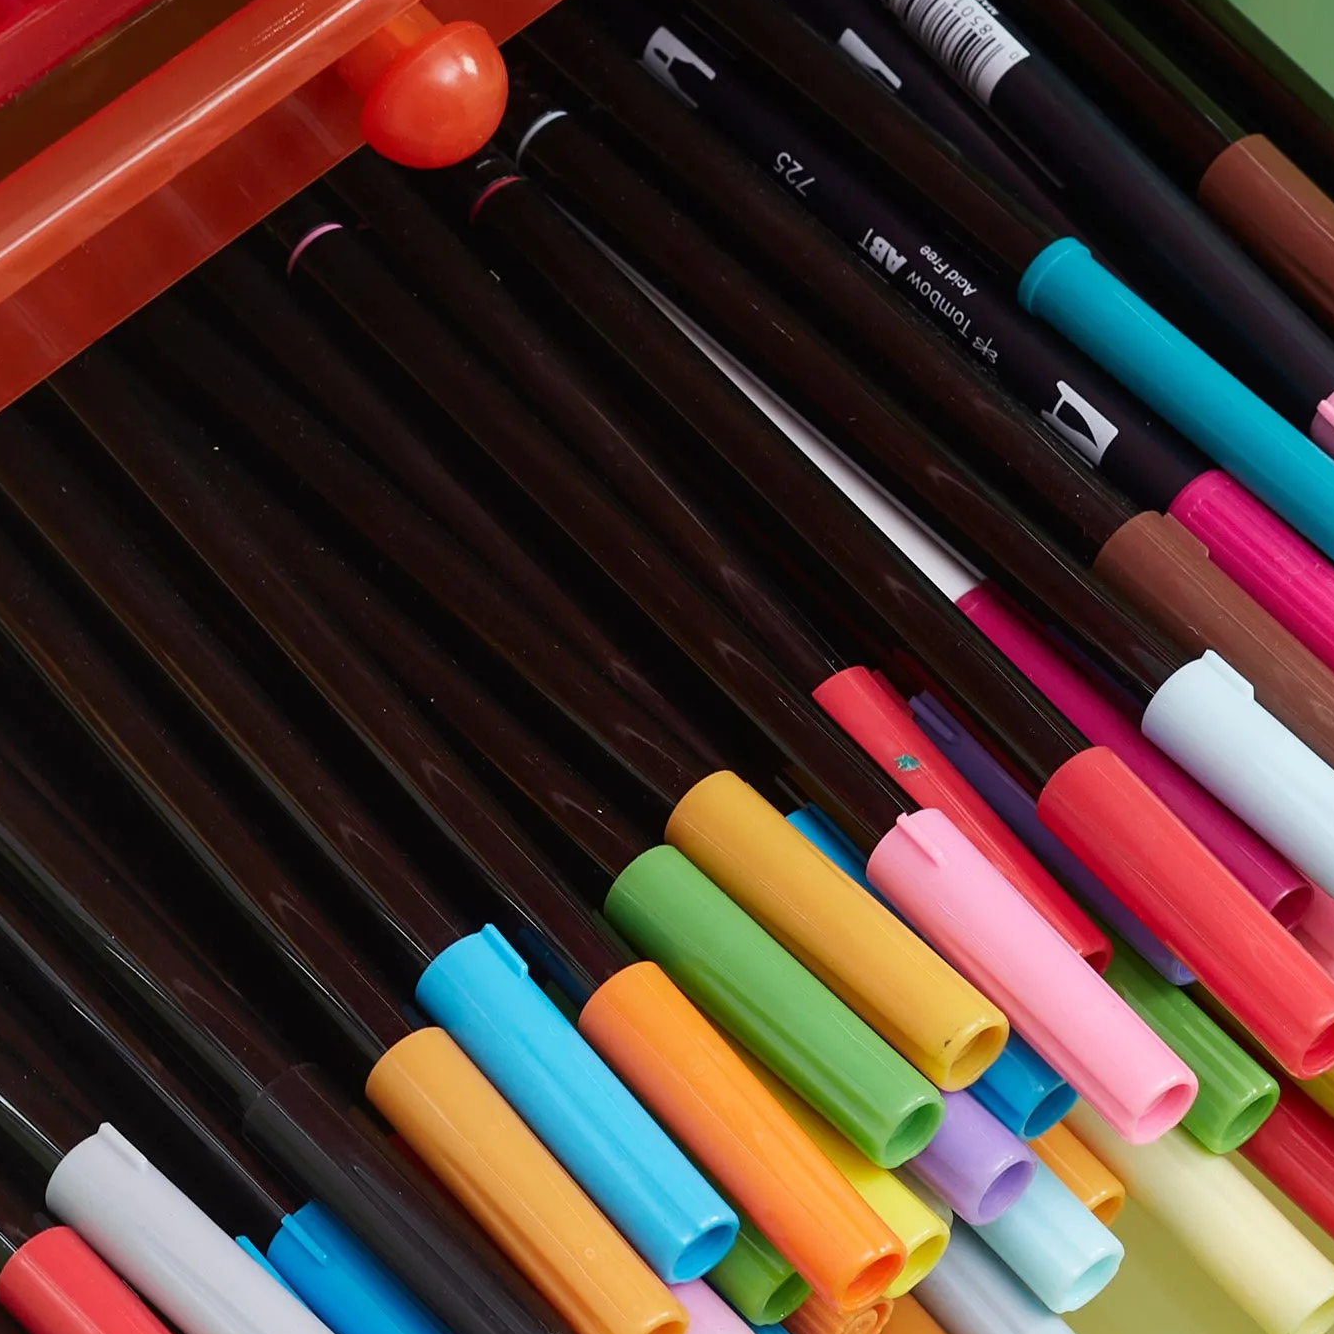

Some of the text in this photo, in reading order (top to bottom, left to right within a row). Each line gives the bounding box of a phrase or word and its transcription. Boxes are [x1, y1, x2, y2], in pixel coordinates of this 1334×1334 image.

[772, 151, 972, 339] Tombow ABT 725
[919, 244, 978, 297] Acid Free
